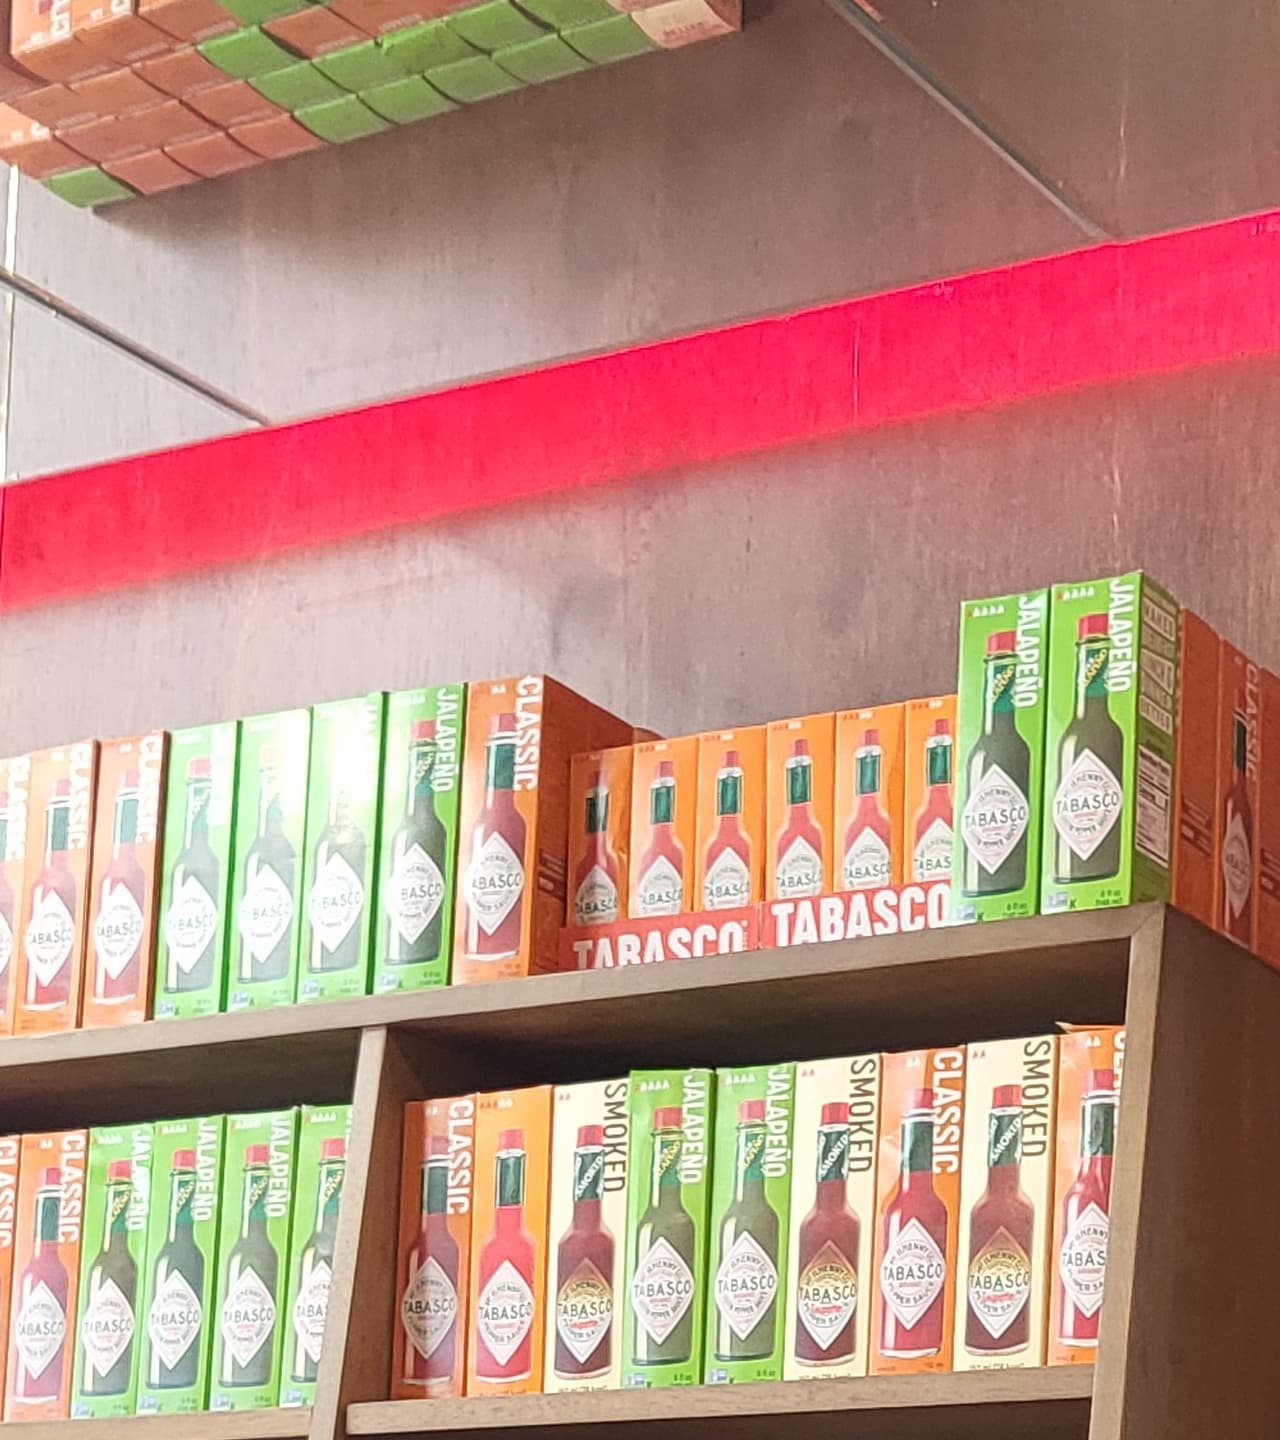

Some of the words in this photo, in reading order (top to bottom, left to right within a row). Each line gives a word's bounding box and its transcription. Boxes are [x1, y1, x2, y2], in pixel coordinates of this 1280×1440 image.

[1104, 579, 1136, 692] JALAPEÑO
[1011, 596, 1042, 707] JALAPEÑO
[514, 675, 542, 791] CLASSIC
[1246, 663, 1259, 783] CLASSIC
[430, 688, 458, 792] JALAPEÑO
[1056, 791, 1120, 815] TABASCO
[965, 806, 1026, 829] TABASCO
[914, 856, 952, 871] TABAS
[401, 883, 442, 900] BASCO
[471, 872, 522, 890] ABASCO
[311, 891, 361, 909] BASCO
[171, 914, 214, 931] BASC
[771, 883, 951, 948] TABASCO
[28, 928, 71, 944] ABASCO
[573, 921, 744, 970] TABASCO
[1022, 1040, 1051, 1157] SMOKED
[761, 1068, 791, 1177] JALAPEÑO
[848, 1058, 876, 1174] SMOKED
[932, 1051, 963, 1175] CLASSIC
[602, 1082, 628, 1193] SMOKED
[676, 1075, 707, 1184] JALAPEÑO
[264, 1117, 291, 1217] JALAPEÑO
[446, 1099, 473, 1215] CLASSIC
[191, 1120, 218, 1221] JALAPEÑO
[59, 1134, 85, 1244] CLASSIC
[1062, 1250, 1105, 1268] TABAS
[885, 1263, 943, 1281] TABASCO
[970, 1272, 1029, 1292] TABASCO
[634, 1280, 691, 1298] TABASCO
[718, 1275, 775, 1294] TABASCO
[800, 1284, 856, 1304] TABASCO
[224, 1308, 273, 1324] TABASCO
[296, 1302, 328, 1319] TABA
[404, 1297, 455, 1314] TABASCO
[480, 1302, 532, 1321] TABASCO
[558, 1299, 613, 1319] TABASCO
[83, 1318, 133, 1335] TABASCO
[151, 1310, 200, 1327] TABASCO
